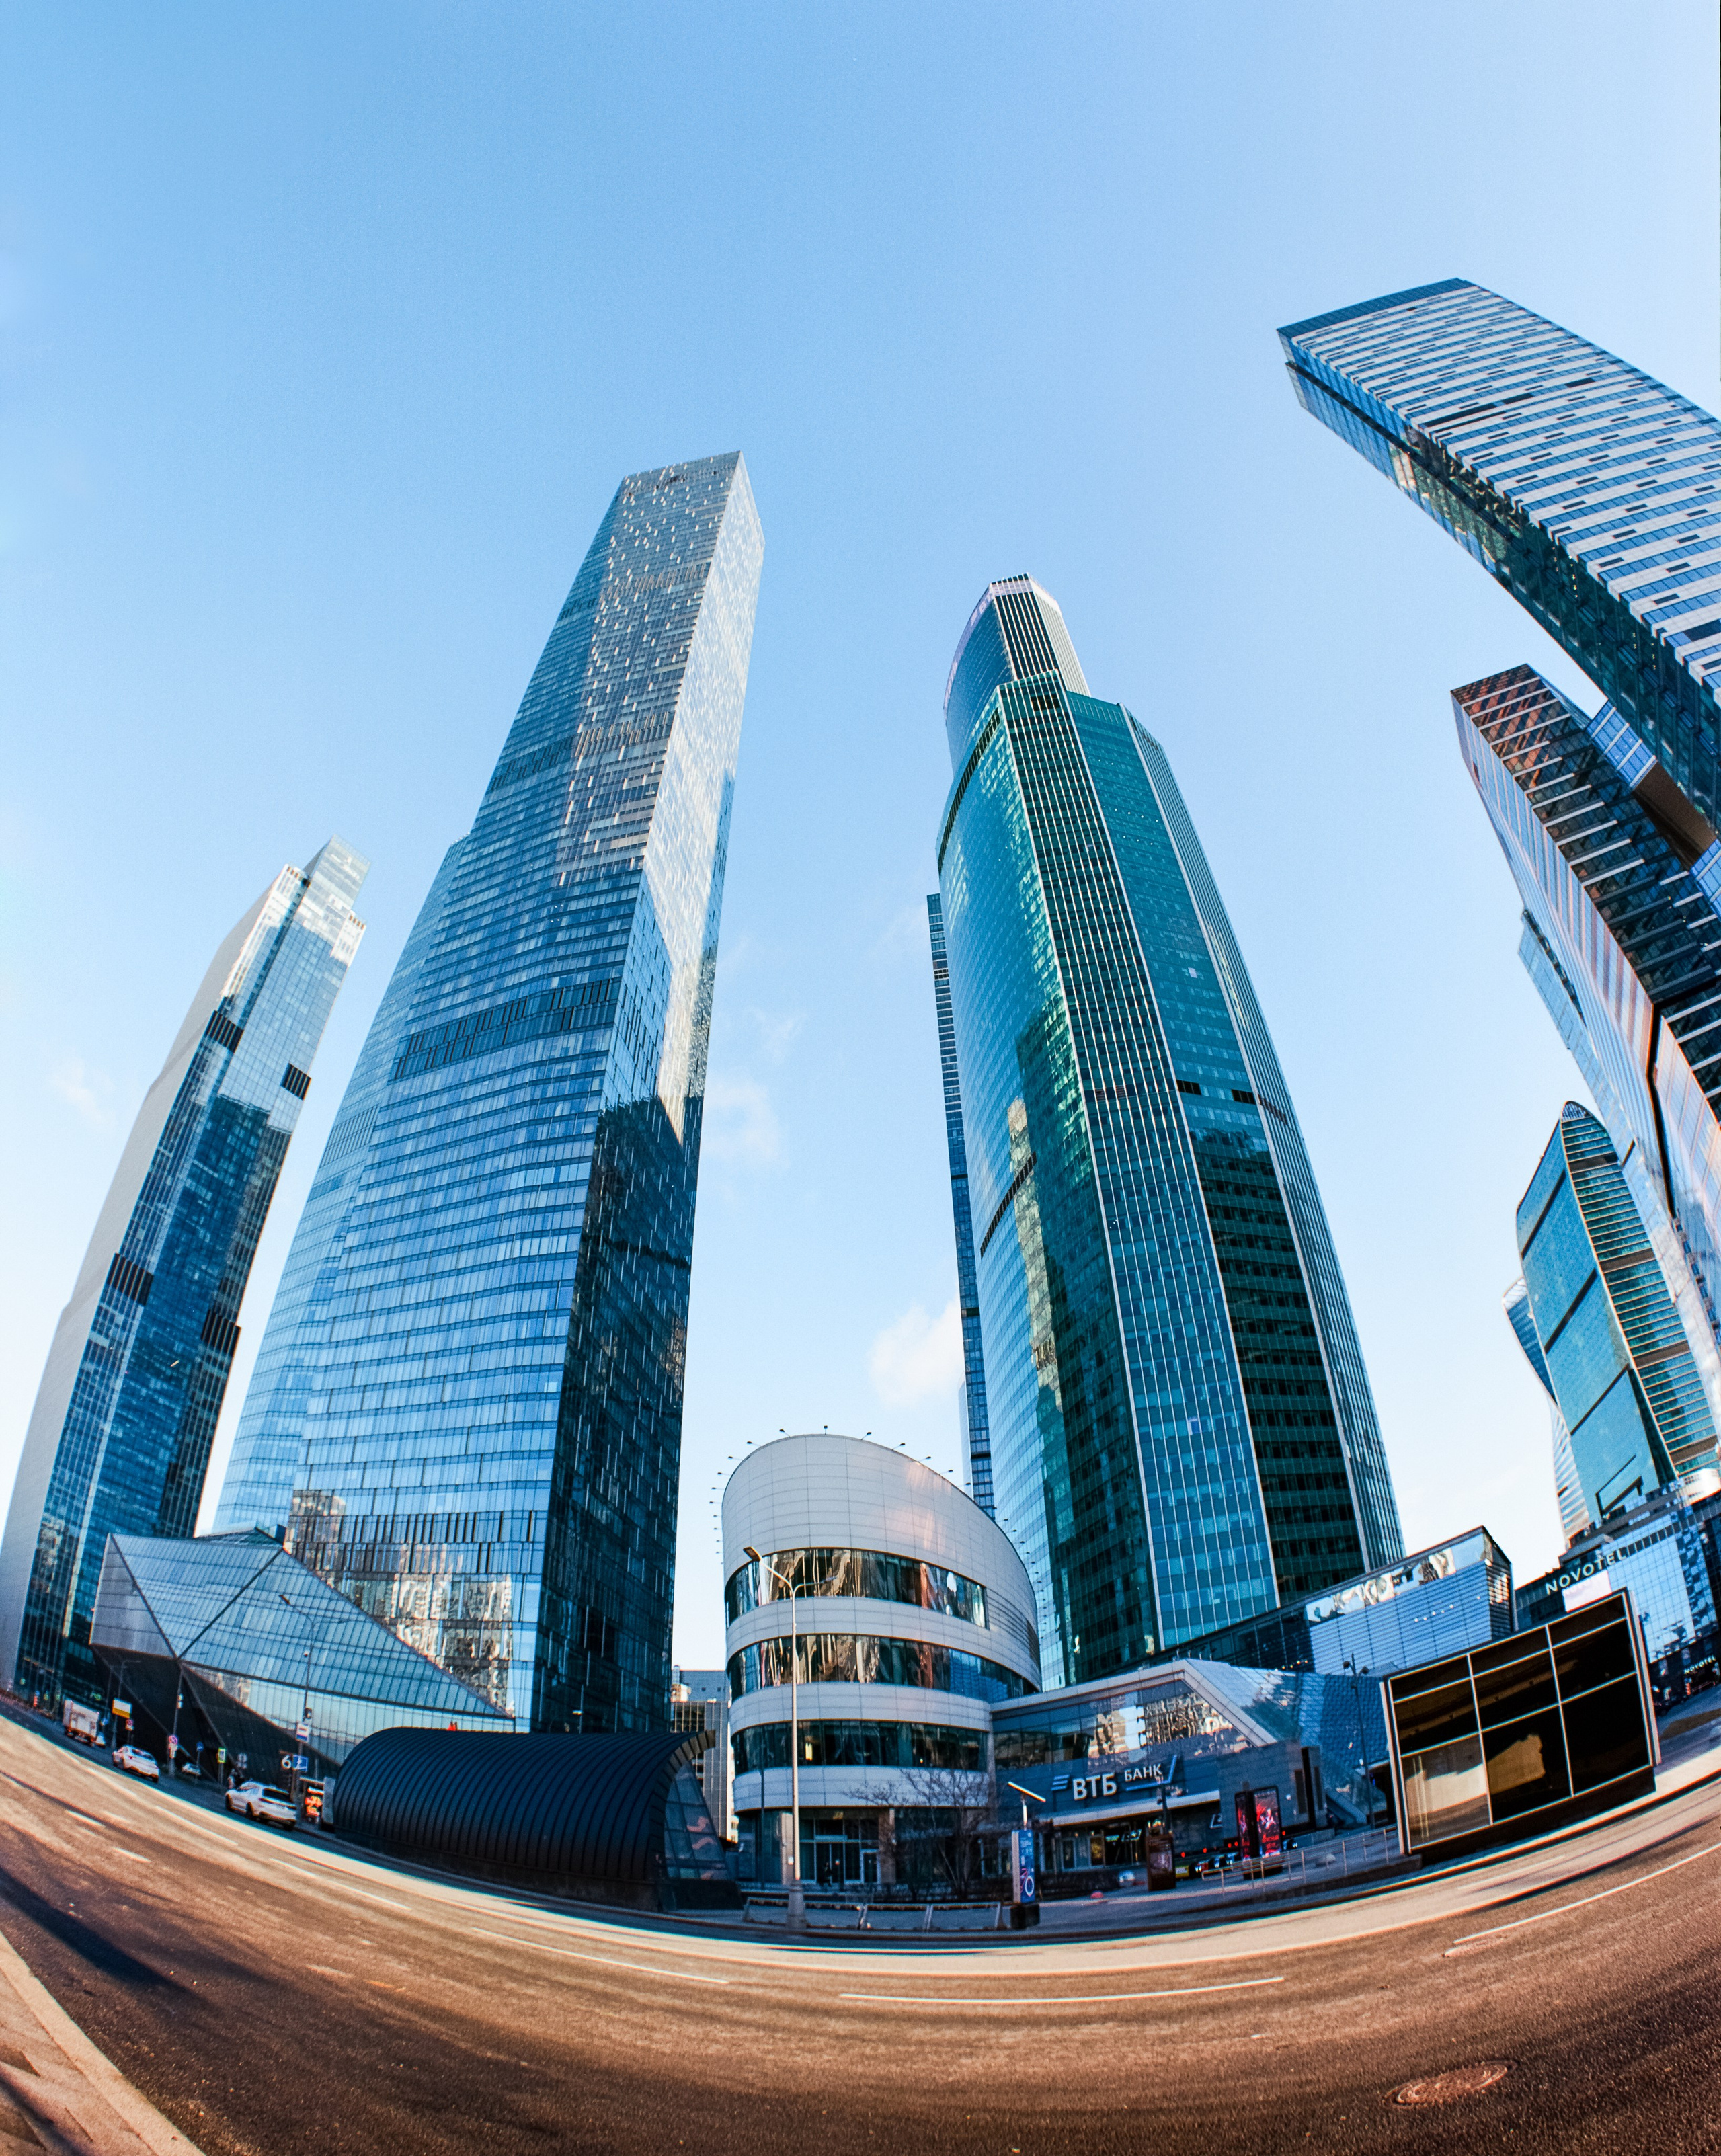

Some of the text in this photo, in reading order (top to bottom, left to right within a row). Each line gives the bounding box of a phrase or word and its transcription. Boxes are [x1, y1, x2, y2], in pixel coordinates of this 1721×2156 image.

[1545, 1548, 1627, 1595] NOVOTEL
[1683, 1655, 1716, 1674] NOVOTEL
[281, 1755, 292, 1770] 6
[1072, 1763, 1162, 1801] ВТБ БАНК
